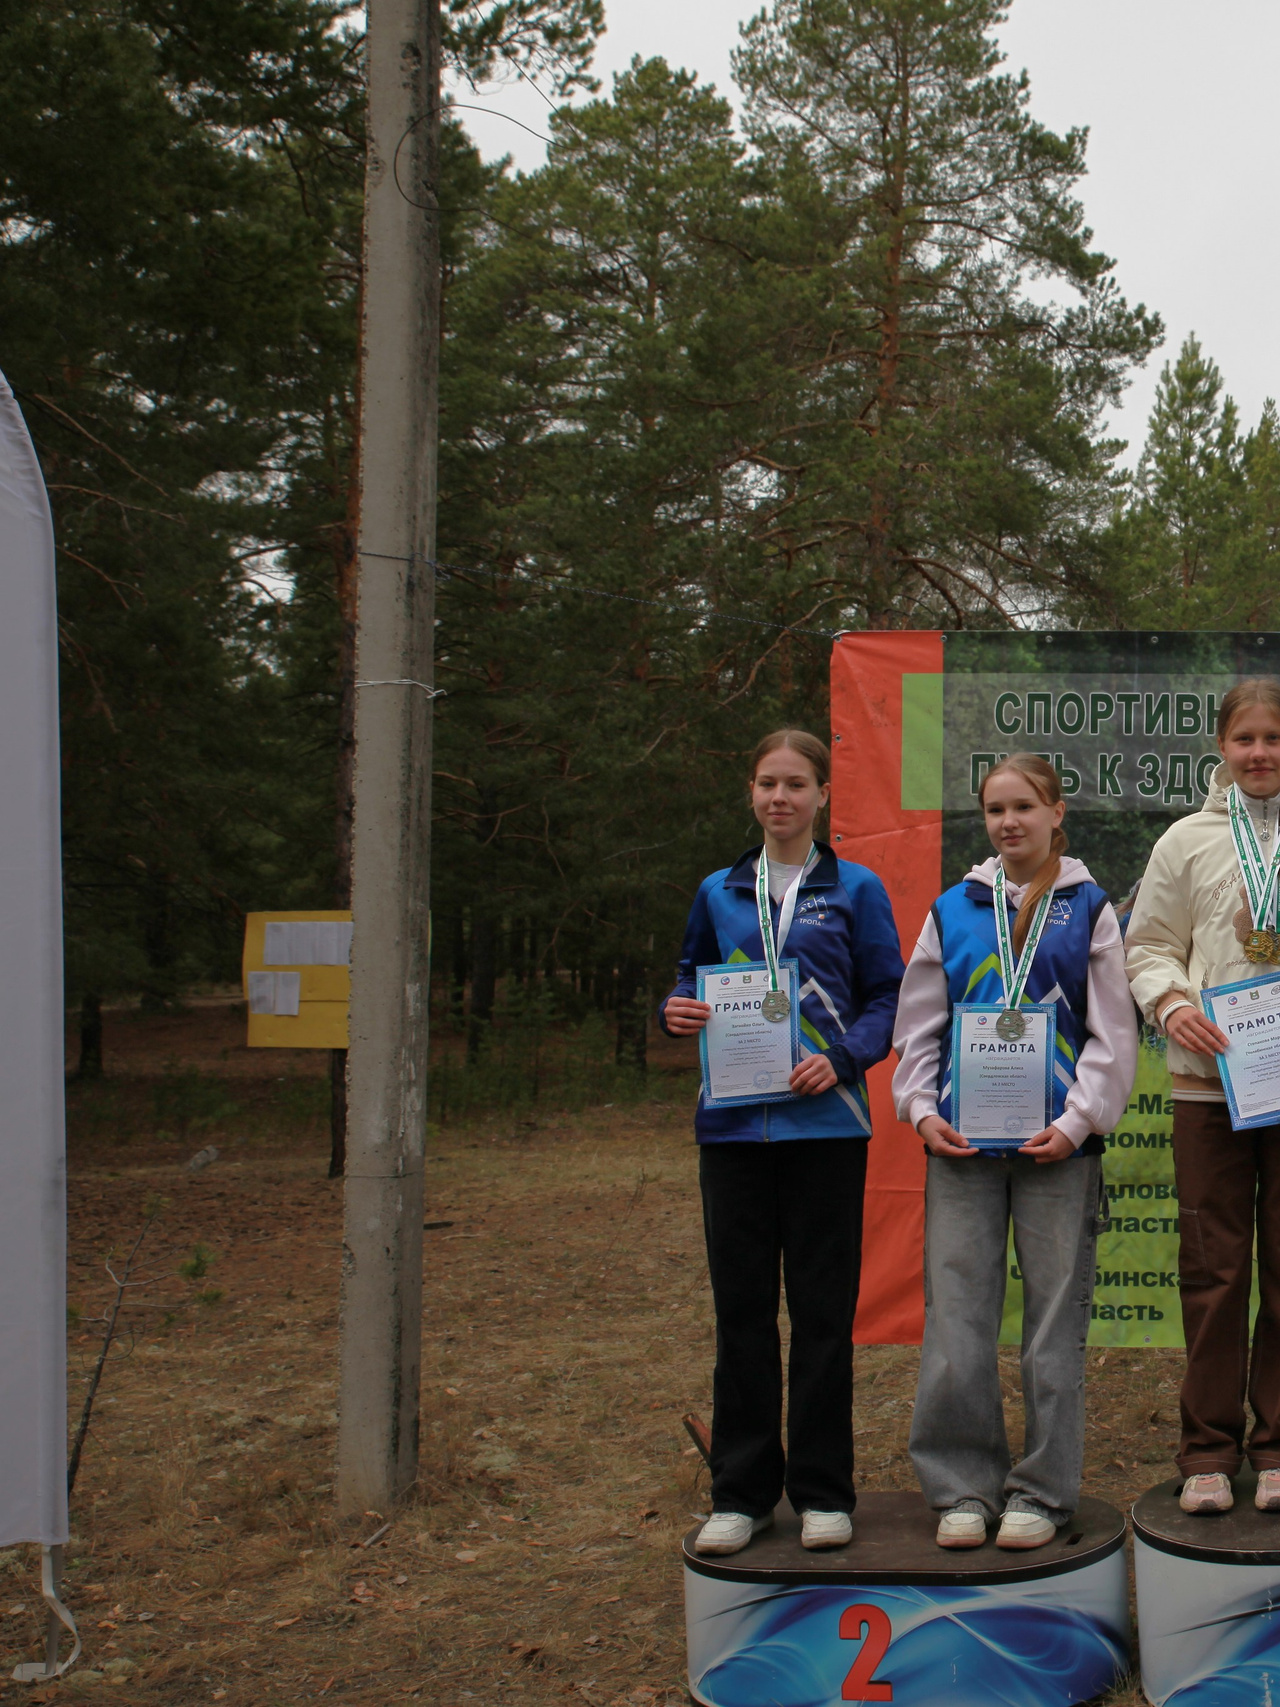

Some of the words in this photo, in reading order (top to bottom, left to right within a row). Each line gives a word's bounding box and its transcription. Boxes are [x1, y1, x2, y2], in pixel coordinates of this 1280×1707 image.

[971, 753, 1081, 796] ПЬ
[1098, 753, 1123, 796] К
[799, 918, 822, 926] ТРОПА
[715, 1000, 762, 1013] ГРАМО
[970, 1043, 1036, 1053] ГРАМОТА
[1091, 1304, 1164, 1320] асть
[839, 1603, 893, 1702] 2
